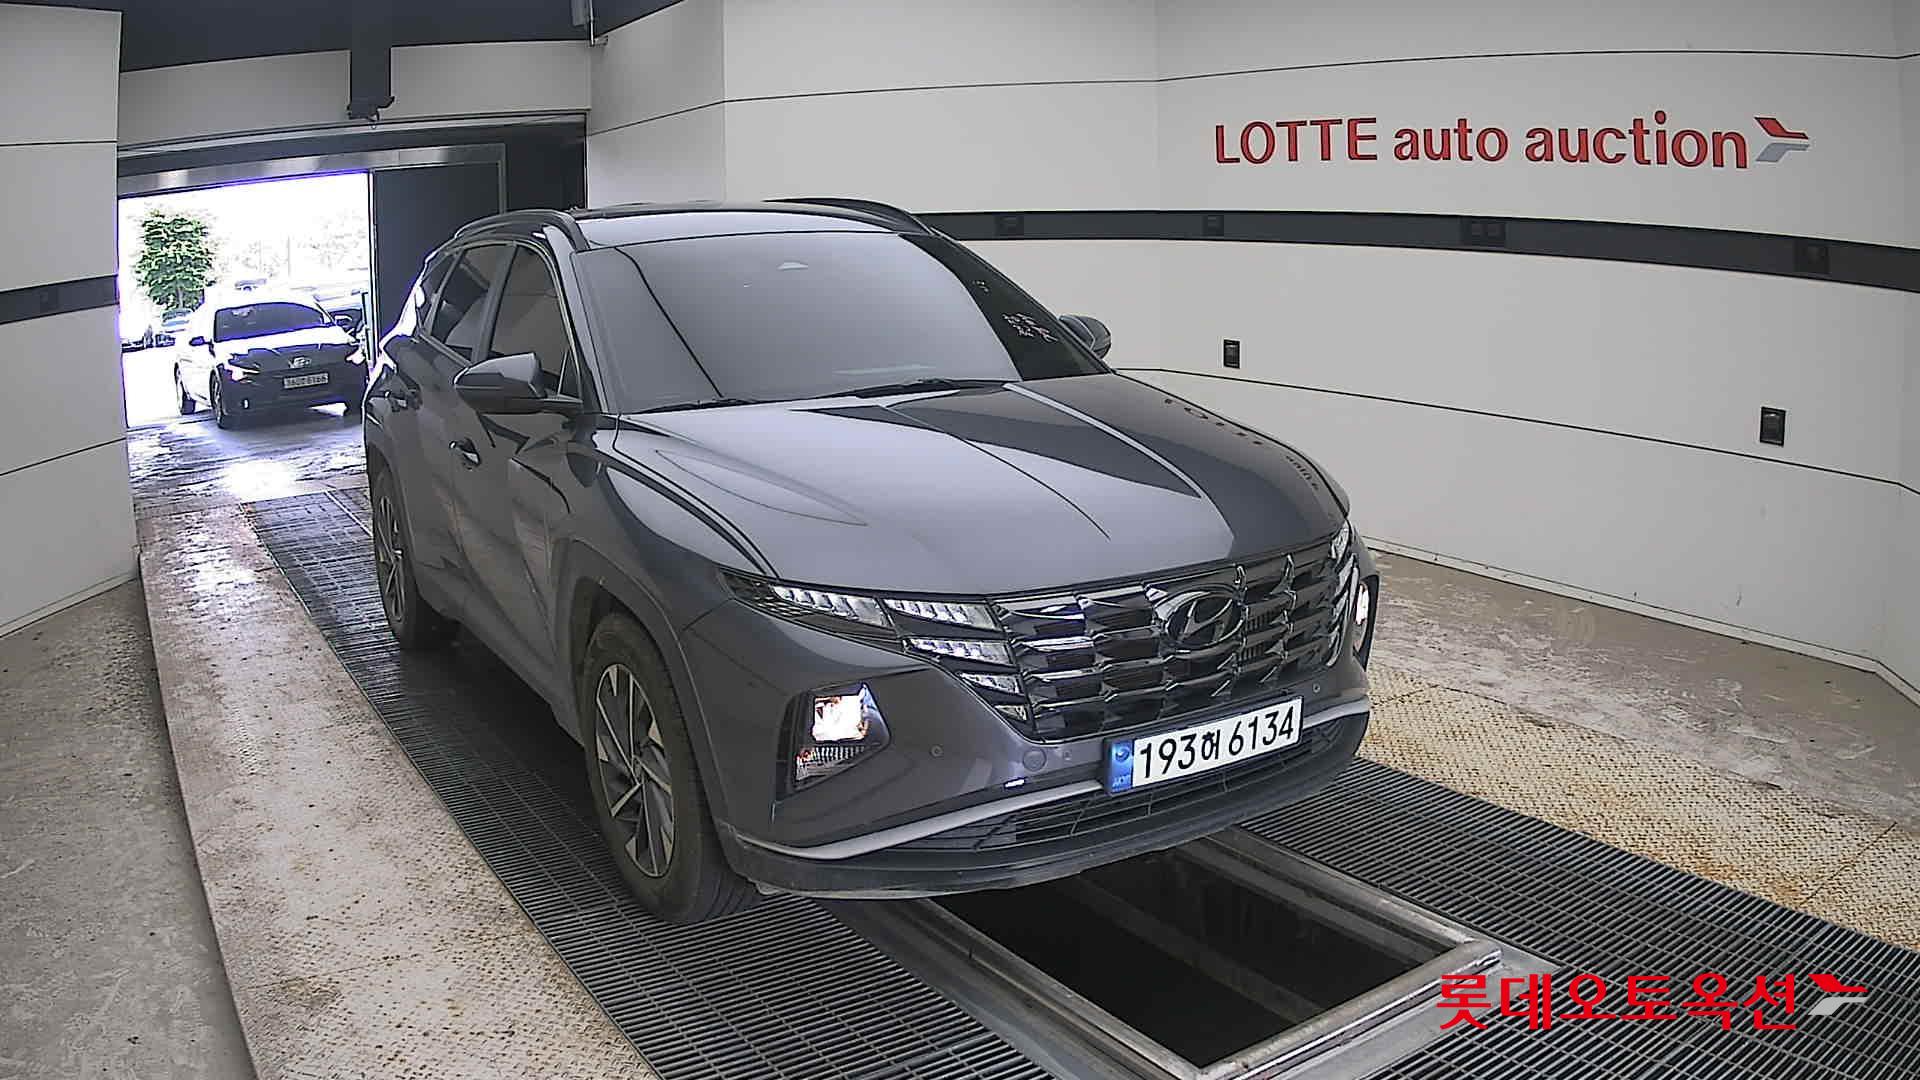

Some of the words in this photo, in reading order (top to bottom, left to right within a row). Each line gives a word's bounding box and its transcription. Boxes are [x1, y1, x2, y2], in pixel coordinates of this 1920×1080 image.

[1215, 118, 1377, 164] LOTTE
[1393, 118, 1509, 163] auto
[1525, 110, 1749, 168] auction
[1140, 729, 1221, 779] 193허
[1228, 706, 1294, 756] 6134
